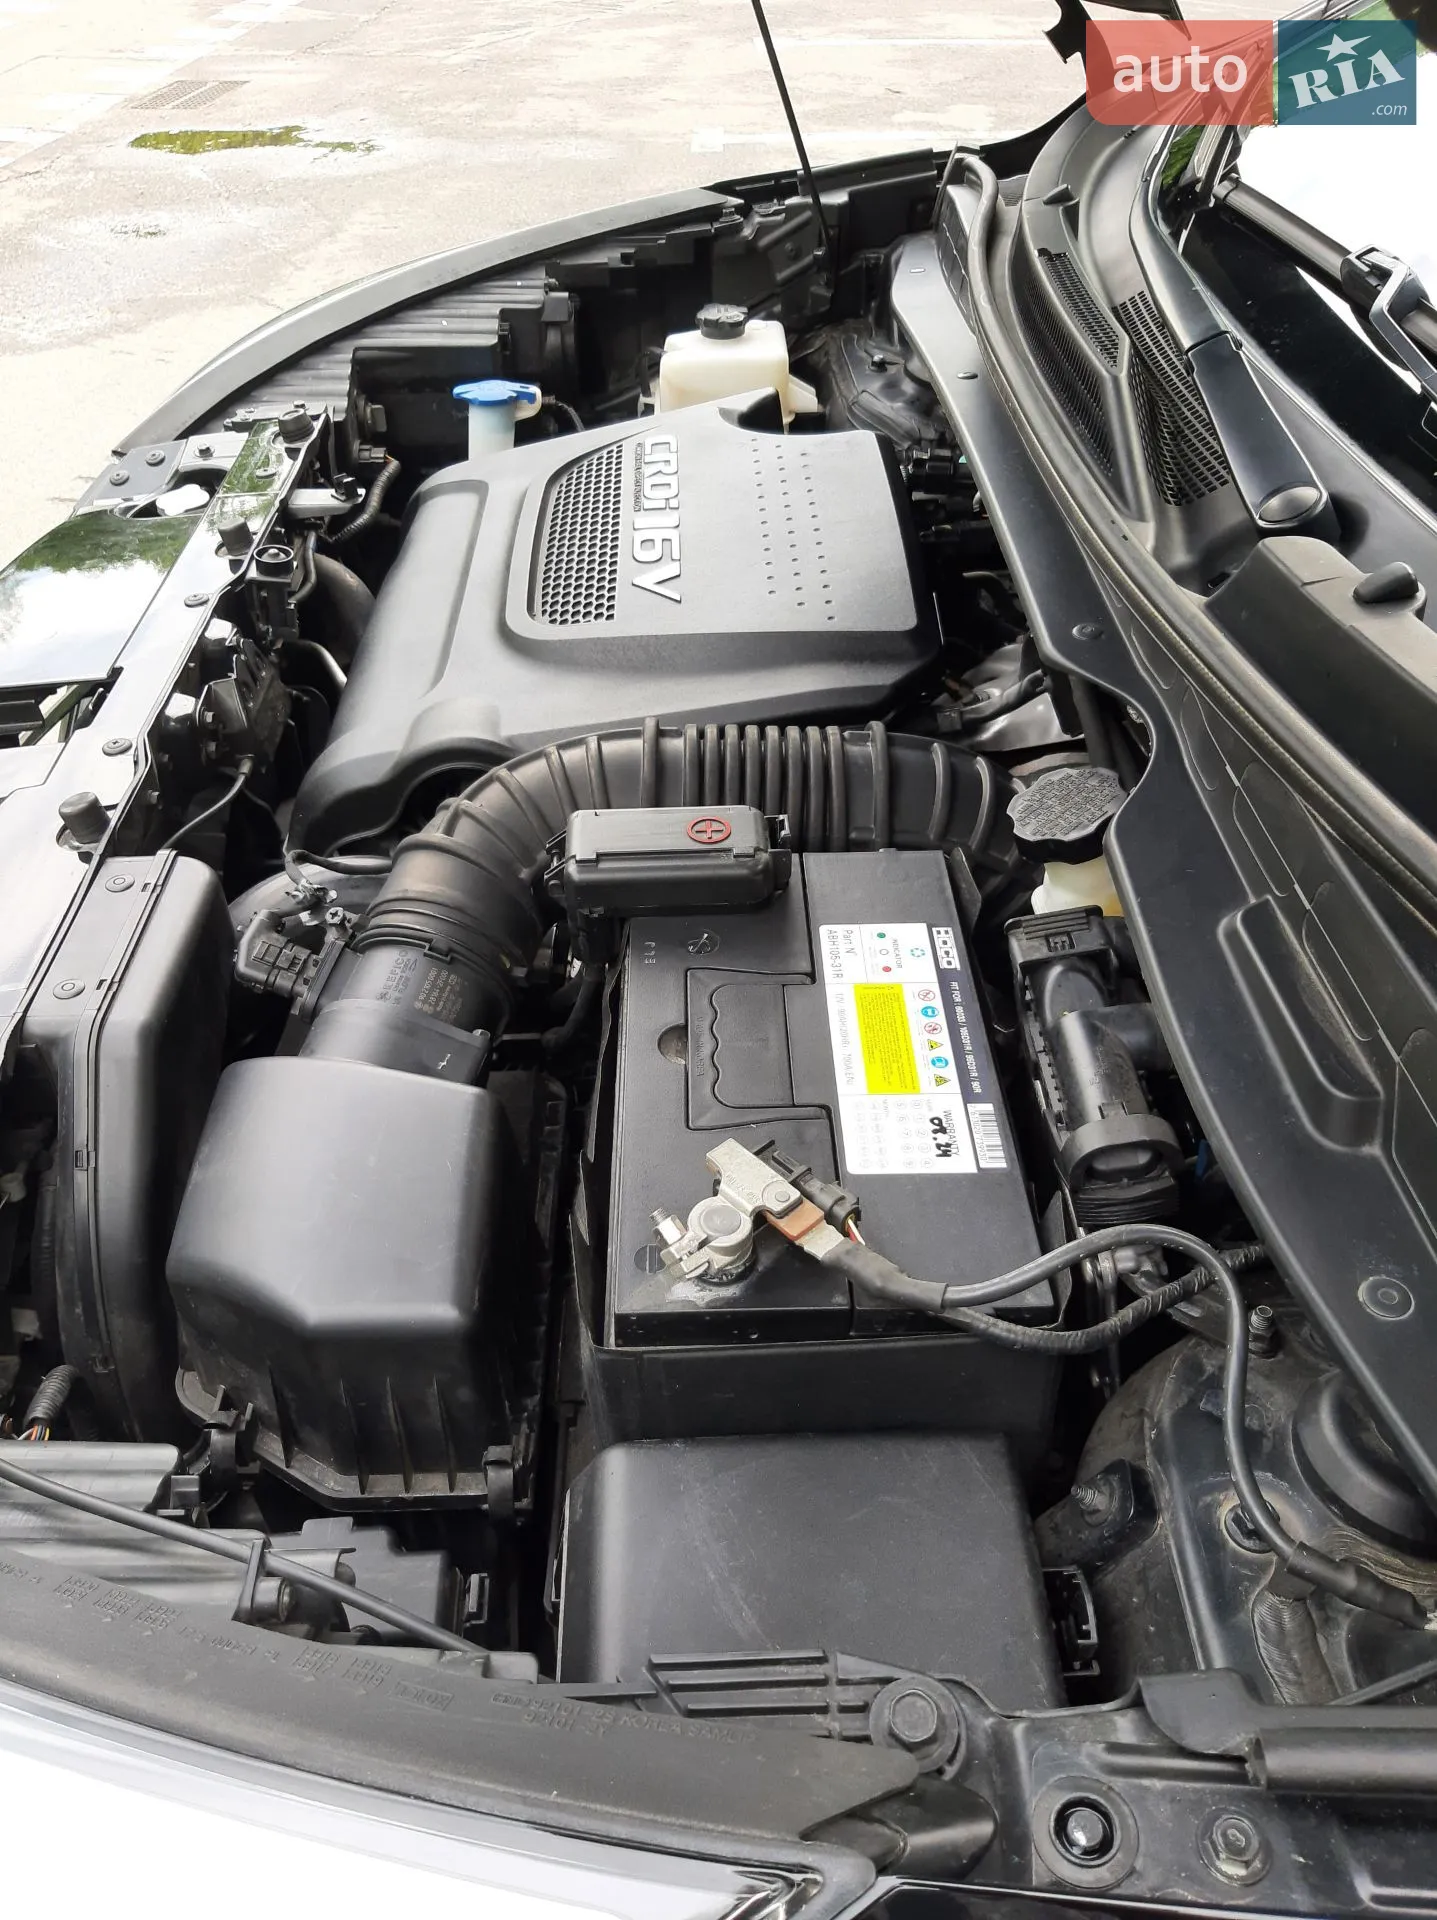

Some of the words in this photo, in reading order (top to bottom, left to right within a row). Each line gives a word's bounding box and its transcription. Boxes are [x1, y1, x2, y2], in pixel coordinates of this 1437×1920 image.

[843, 929, 854, 945] Part
[827, 929, 844, 979] ABH105-31R
[892, 938, 903, 969] INDICATOR
[949, 981, 960, 990] FIT
[951, 991, 962, 1003] FOR
[943, 1110, 960, 1156] WARRANTY
[620, 1713, 682, 1734] KOREA
